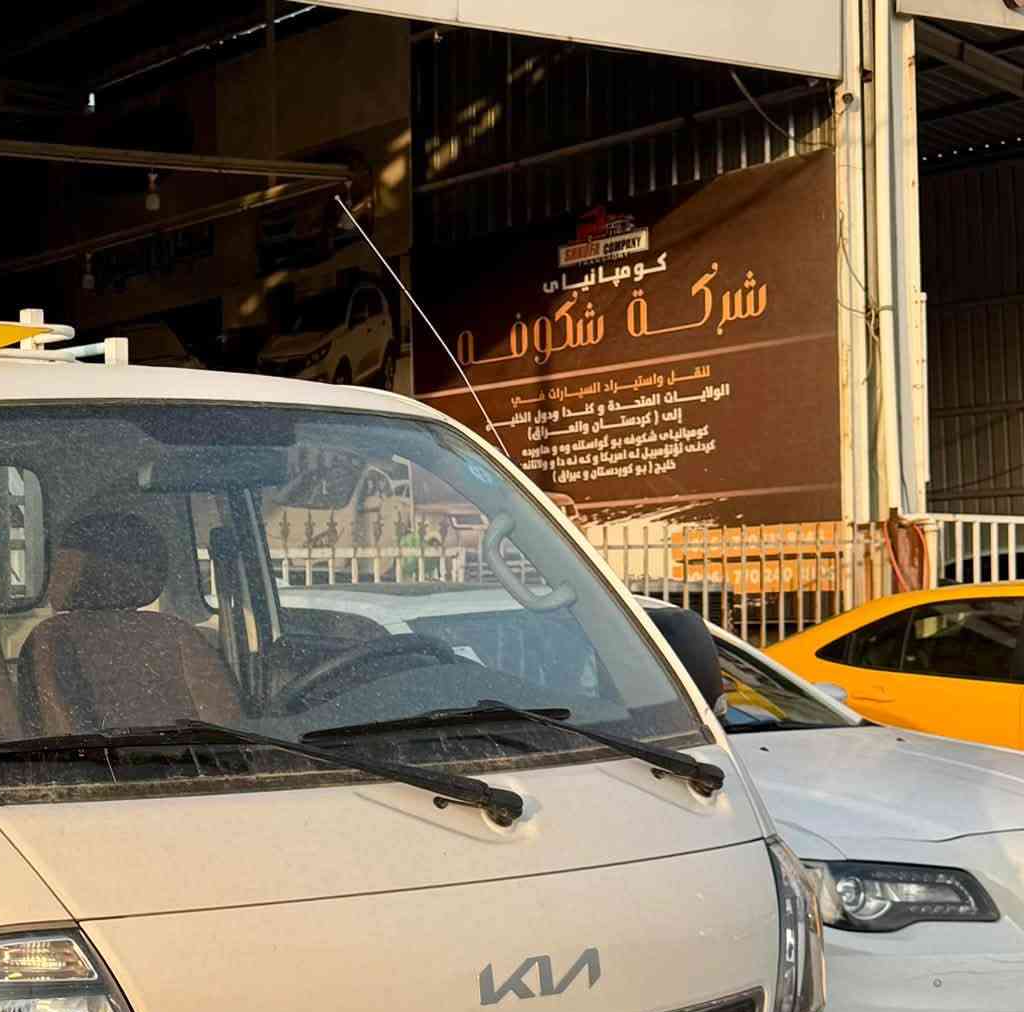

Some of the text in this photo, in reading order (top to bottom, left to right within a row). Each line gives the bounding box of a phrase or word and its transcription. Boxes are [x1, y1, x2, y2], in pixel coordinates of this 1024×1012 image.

[627, 262, 768, 336] شركة
[607, 393, 661, 411] المتحدة
[664, 383, 730, 404] الولايات
[479, 947, 601, 1005] KIA
